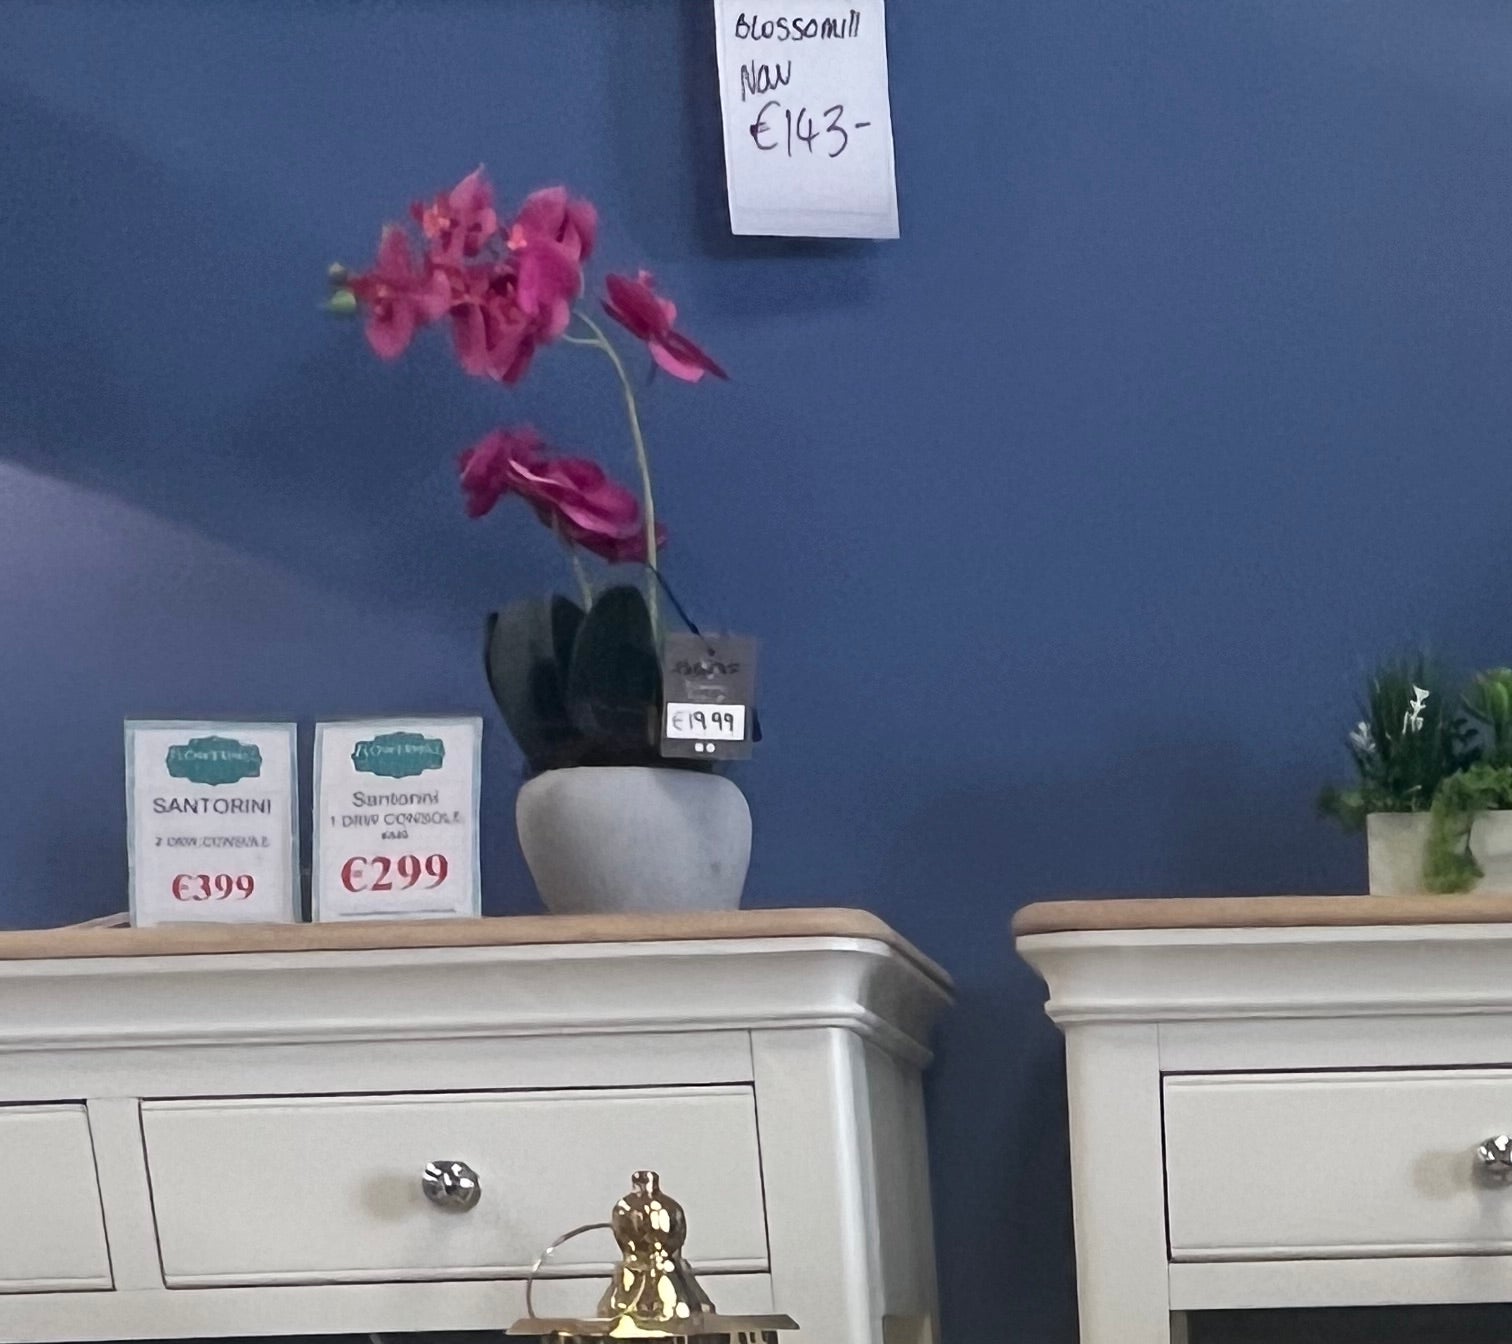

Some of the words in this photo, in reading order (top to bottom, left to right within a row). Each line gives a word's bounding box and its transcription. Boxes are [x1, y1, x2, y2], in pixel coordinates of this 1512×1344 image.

[152, 797, 272, 815] SANTORINI
[351, 790, 440, 807] Santorini
[340, 853, 448, 893] €299
[171, 873, 256, 902] €399
